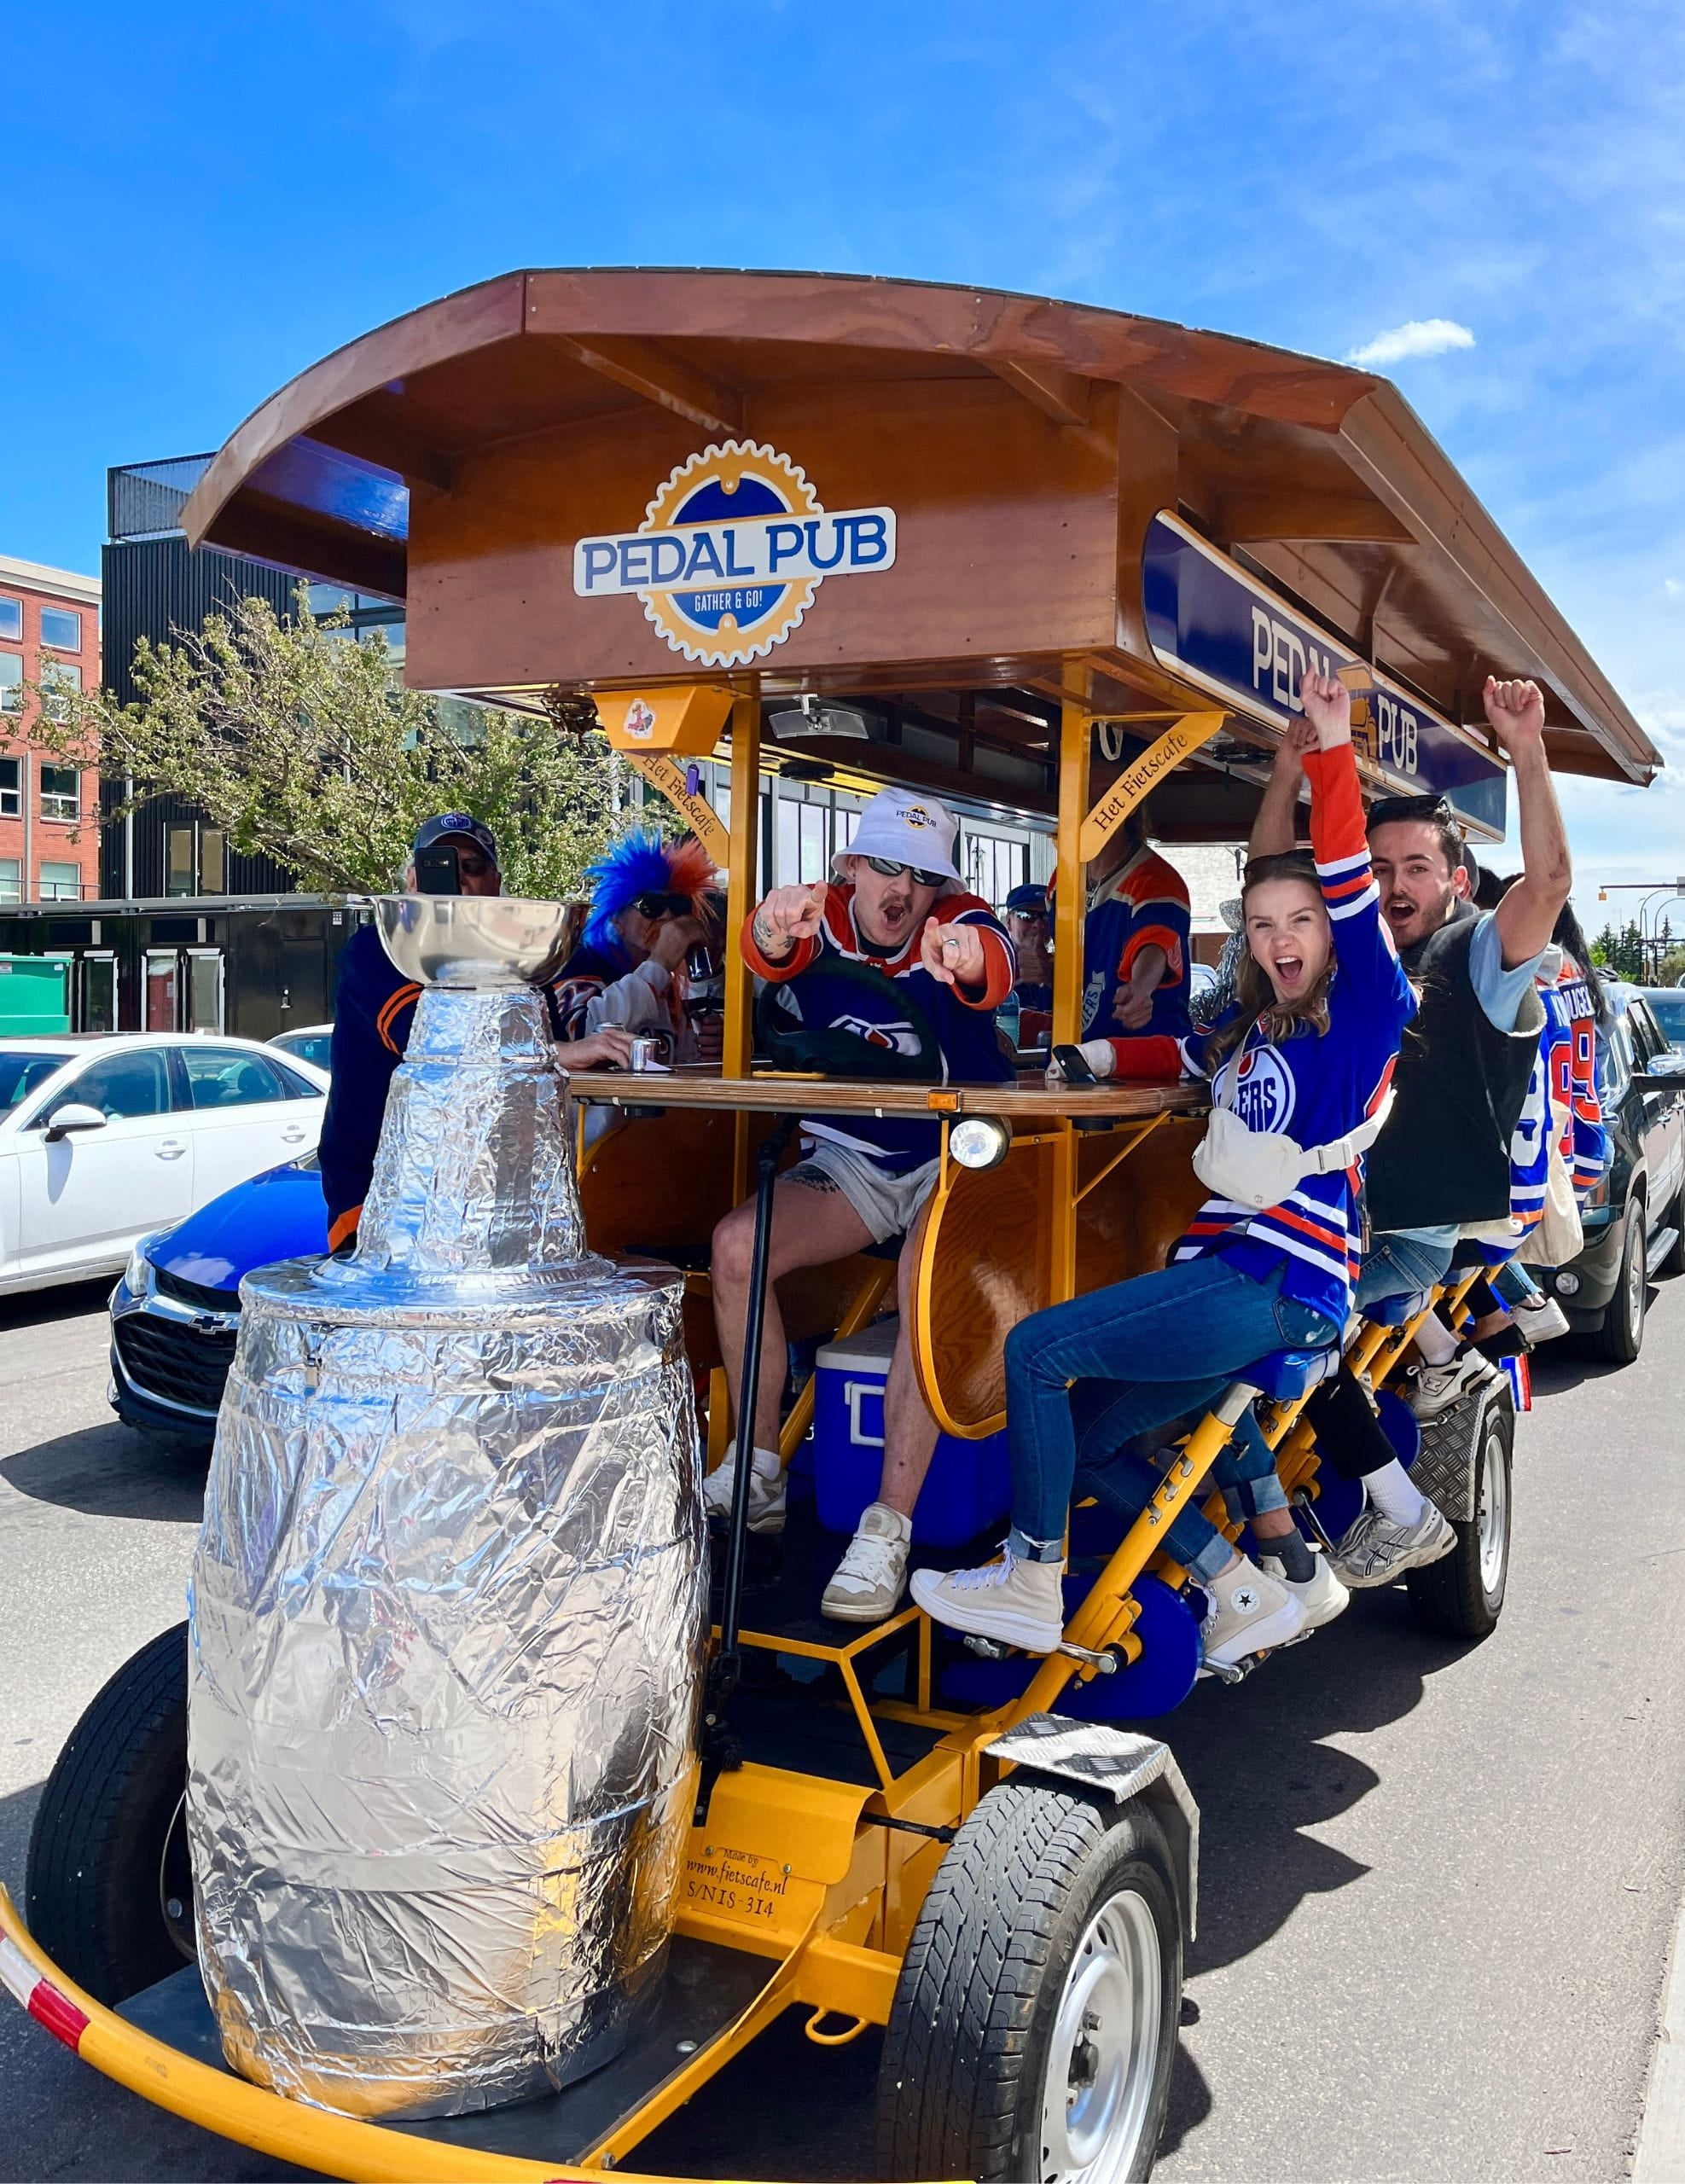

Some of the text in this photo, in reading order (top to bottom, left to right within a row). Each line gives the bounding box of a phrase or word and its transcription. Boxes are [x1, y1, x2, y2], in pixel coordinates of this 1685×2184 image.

[583, 514, 886, 589] PEDAL PUB
[694, 590, 762, 612] GATHER & GO!
[1377, 694, 1418, 775] PUB
[642, 757, 670, 781] Het
[1092, 733, 1188, 832] Het Fietscafe
[896, 810, 937, 828] PEDAL PUB
[723, 1849, 758, 1868] Made by
[686, 1860, 788, 1895] www.fietscafe.nl
